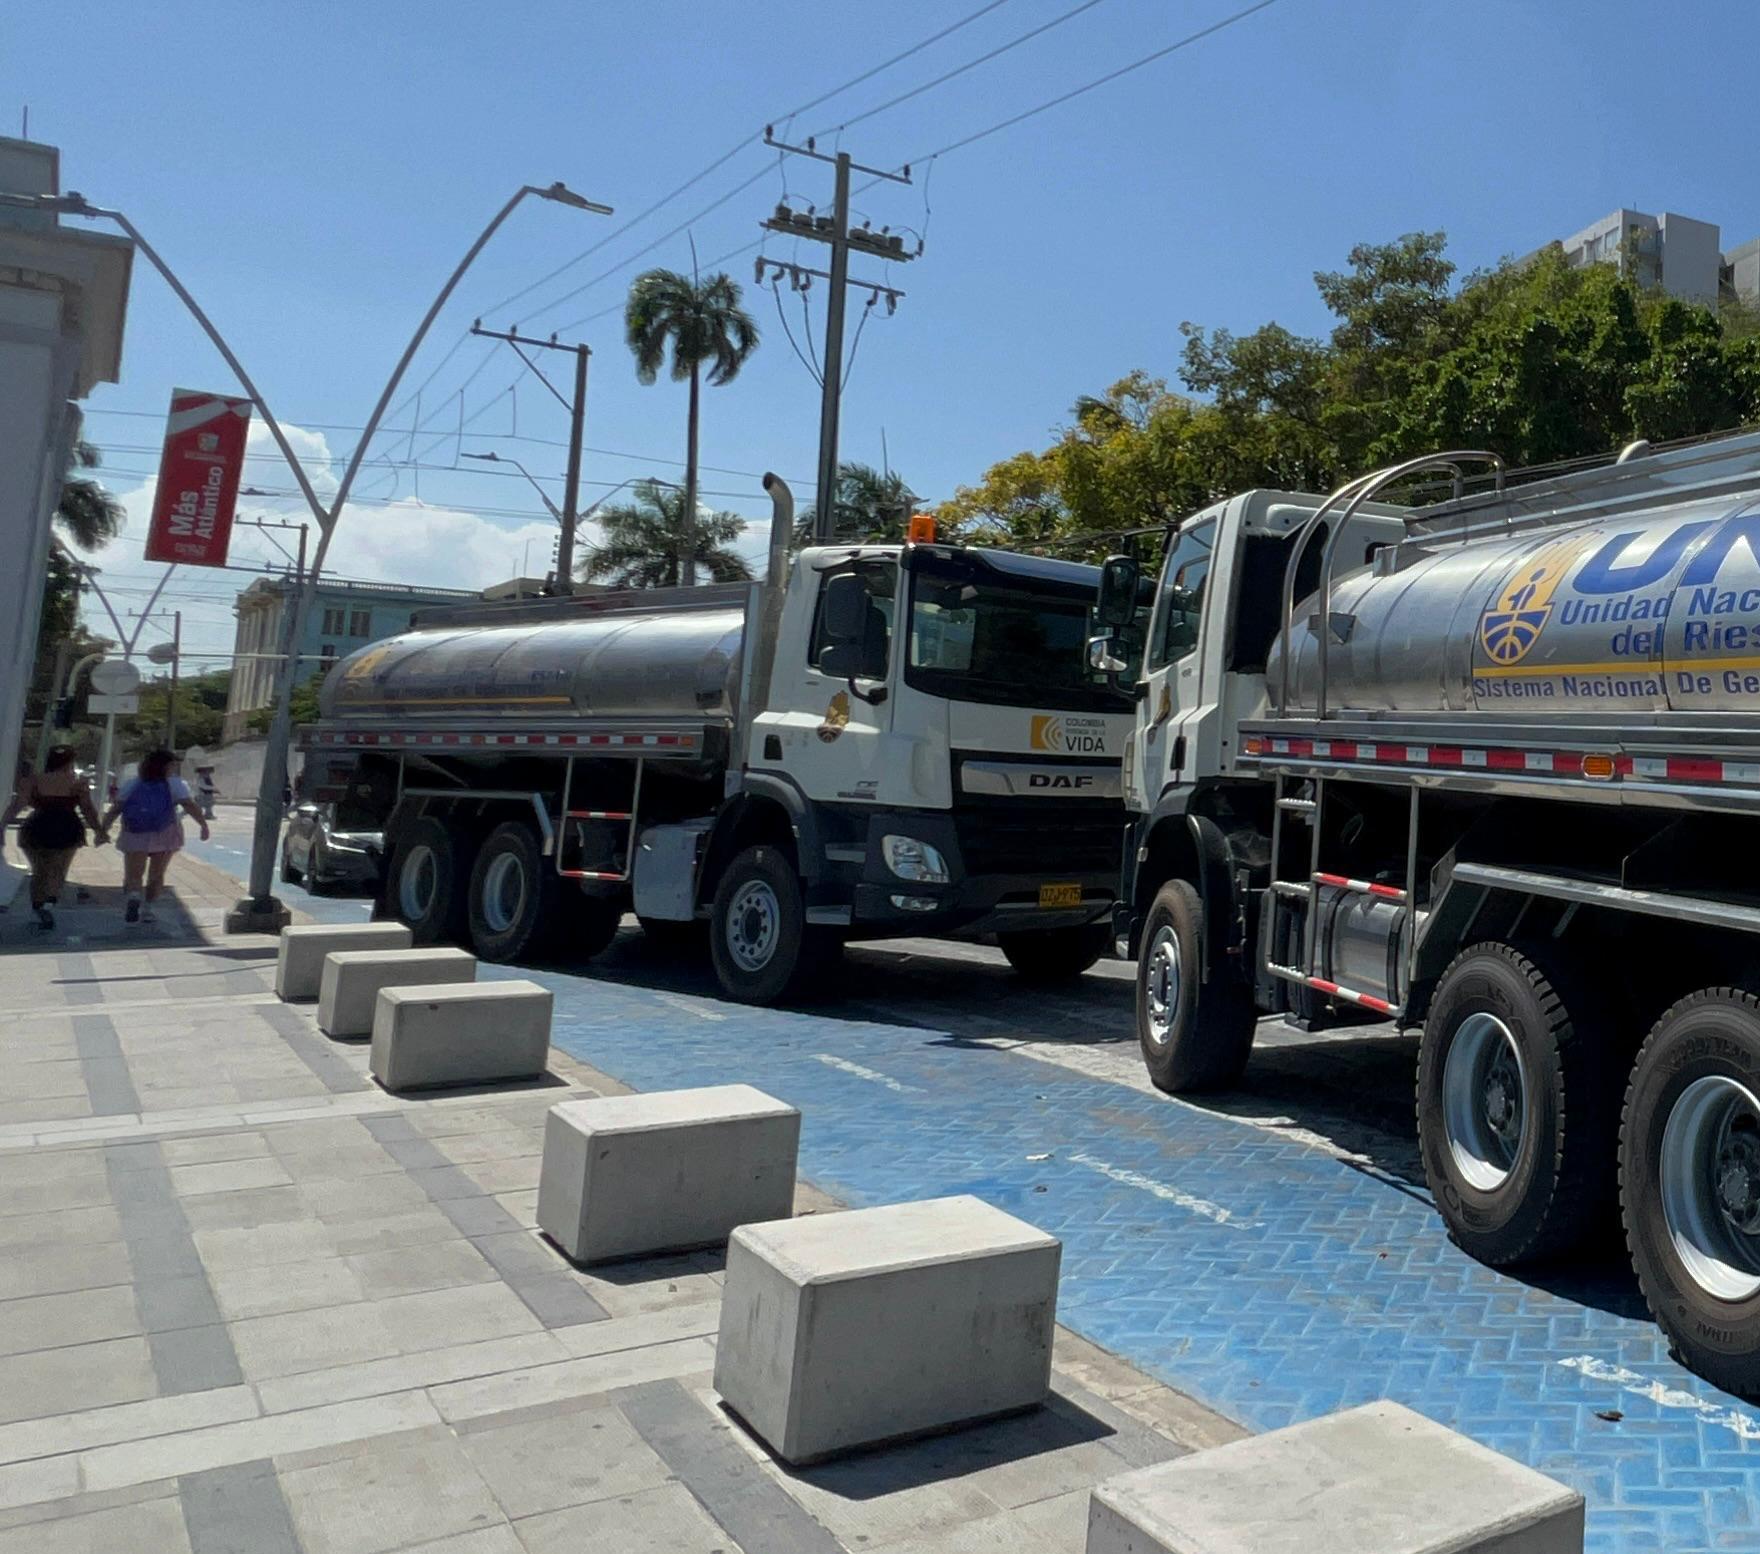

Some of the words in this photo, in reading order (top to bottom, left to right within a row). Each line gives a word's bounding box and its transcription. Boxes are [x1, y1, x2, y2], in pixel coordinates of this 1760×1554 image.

[168, 490, 198, 536] Más
[195, 466, 223, 539] Atlántico
[1560, 590, 1672, 626] Unidad
[1611, 622, 1662, 656] del
[1473, 676, 1554, 698] Sistema
[1562, 674, 1666, 698] Nacional
[1678, 671, 1713, 694] De
[1065, 736, 1105, 753] VIDA
[1029, 774, 1093, 788] DAF
